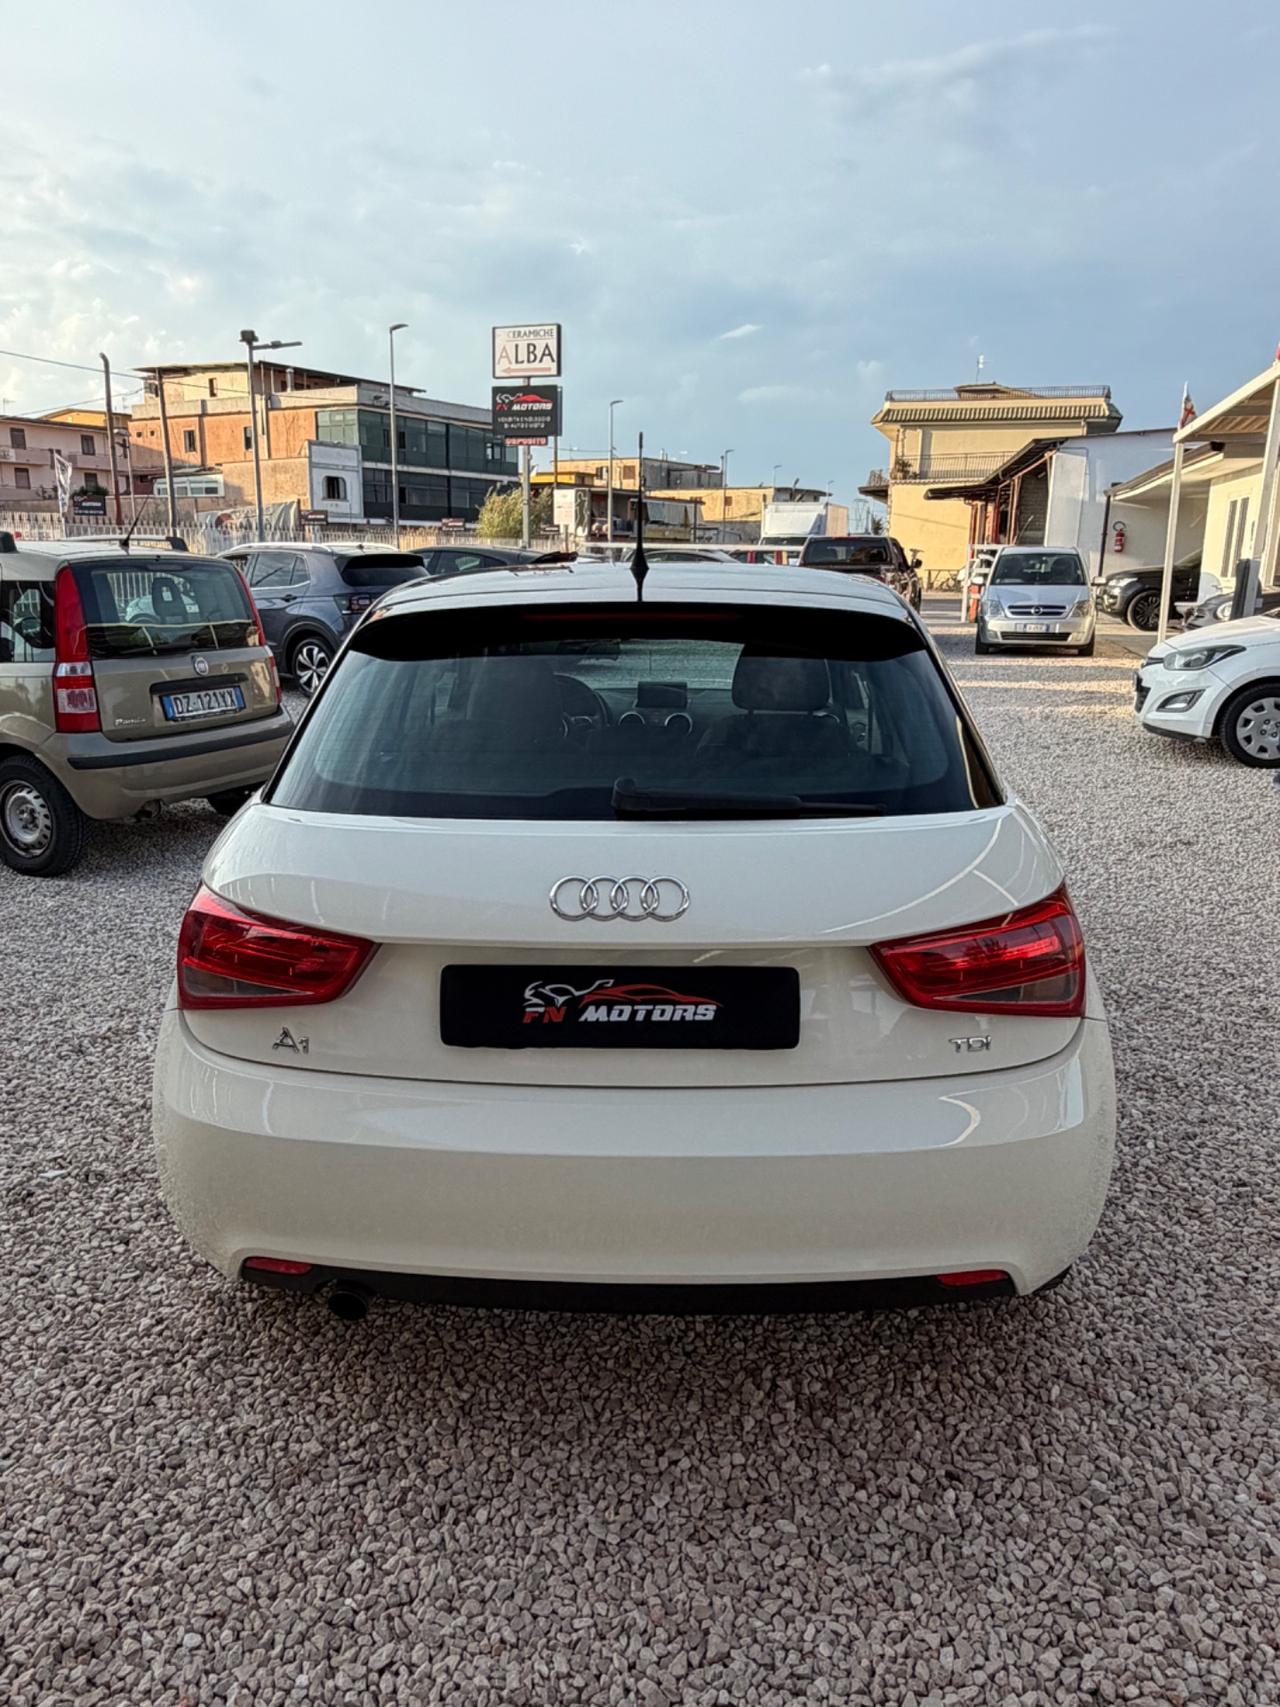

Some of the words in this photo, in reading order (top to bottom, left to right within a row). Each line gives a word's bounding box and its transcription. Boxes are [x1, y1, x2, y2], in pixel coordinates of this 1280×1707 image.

[507, 328, 554, 339] CERAMICHE
[497, 342, 555, 366] ALBA
[511, 402, 553, 411] MOTORS
[523, 1006, 567, 1024] FN
[578, 1004, 717, 1023] MOTORS
[272, 1026, 310, 1055] A1
[948, 1034, 992, 1053] TDI
